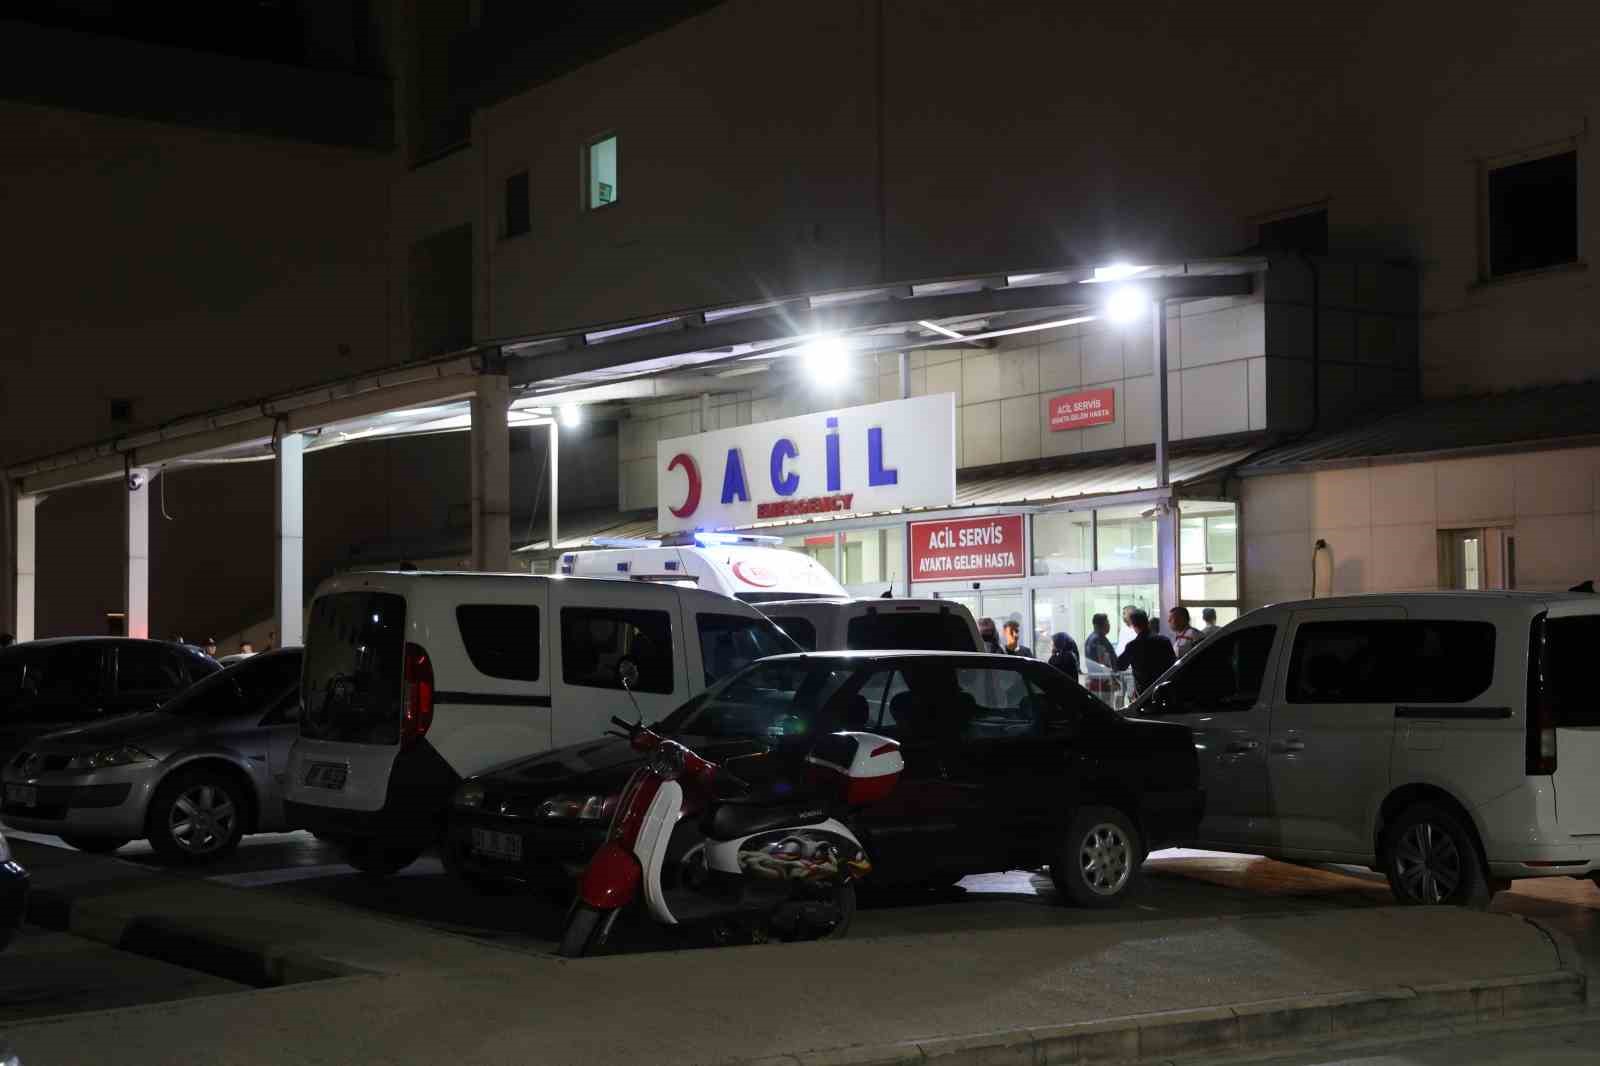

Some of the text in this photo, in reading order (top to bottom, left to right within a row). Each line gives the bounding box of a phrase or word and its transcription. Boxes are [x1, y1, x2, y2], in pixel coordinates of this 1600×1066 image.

[1073, 399, 1101, 411] SERVİS
[721, 417, 898, 505] ACİL
[757, 493, 854, 519] EMERGENCY
[929, 522, 1003, 549] ACİL SERVİS
[919, 552, 1015, 572] AYAKTA GELEN HASTA
